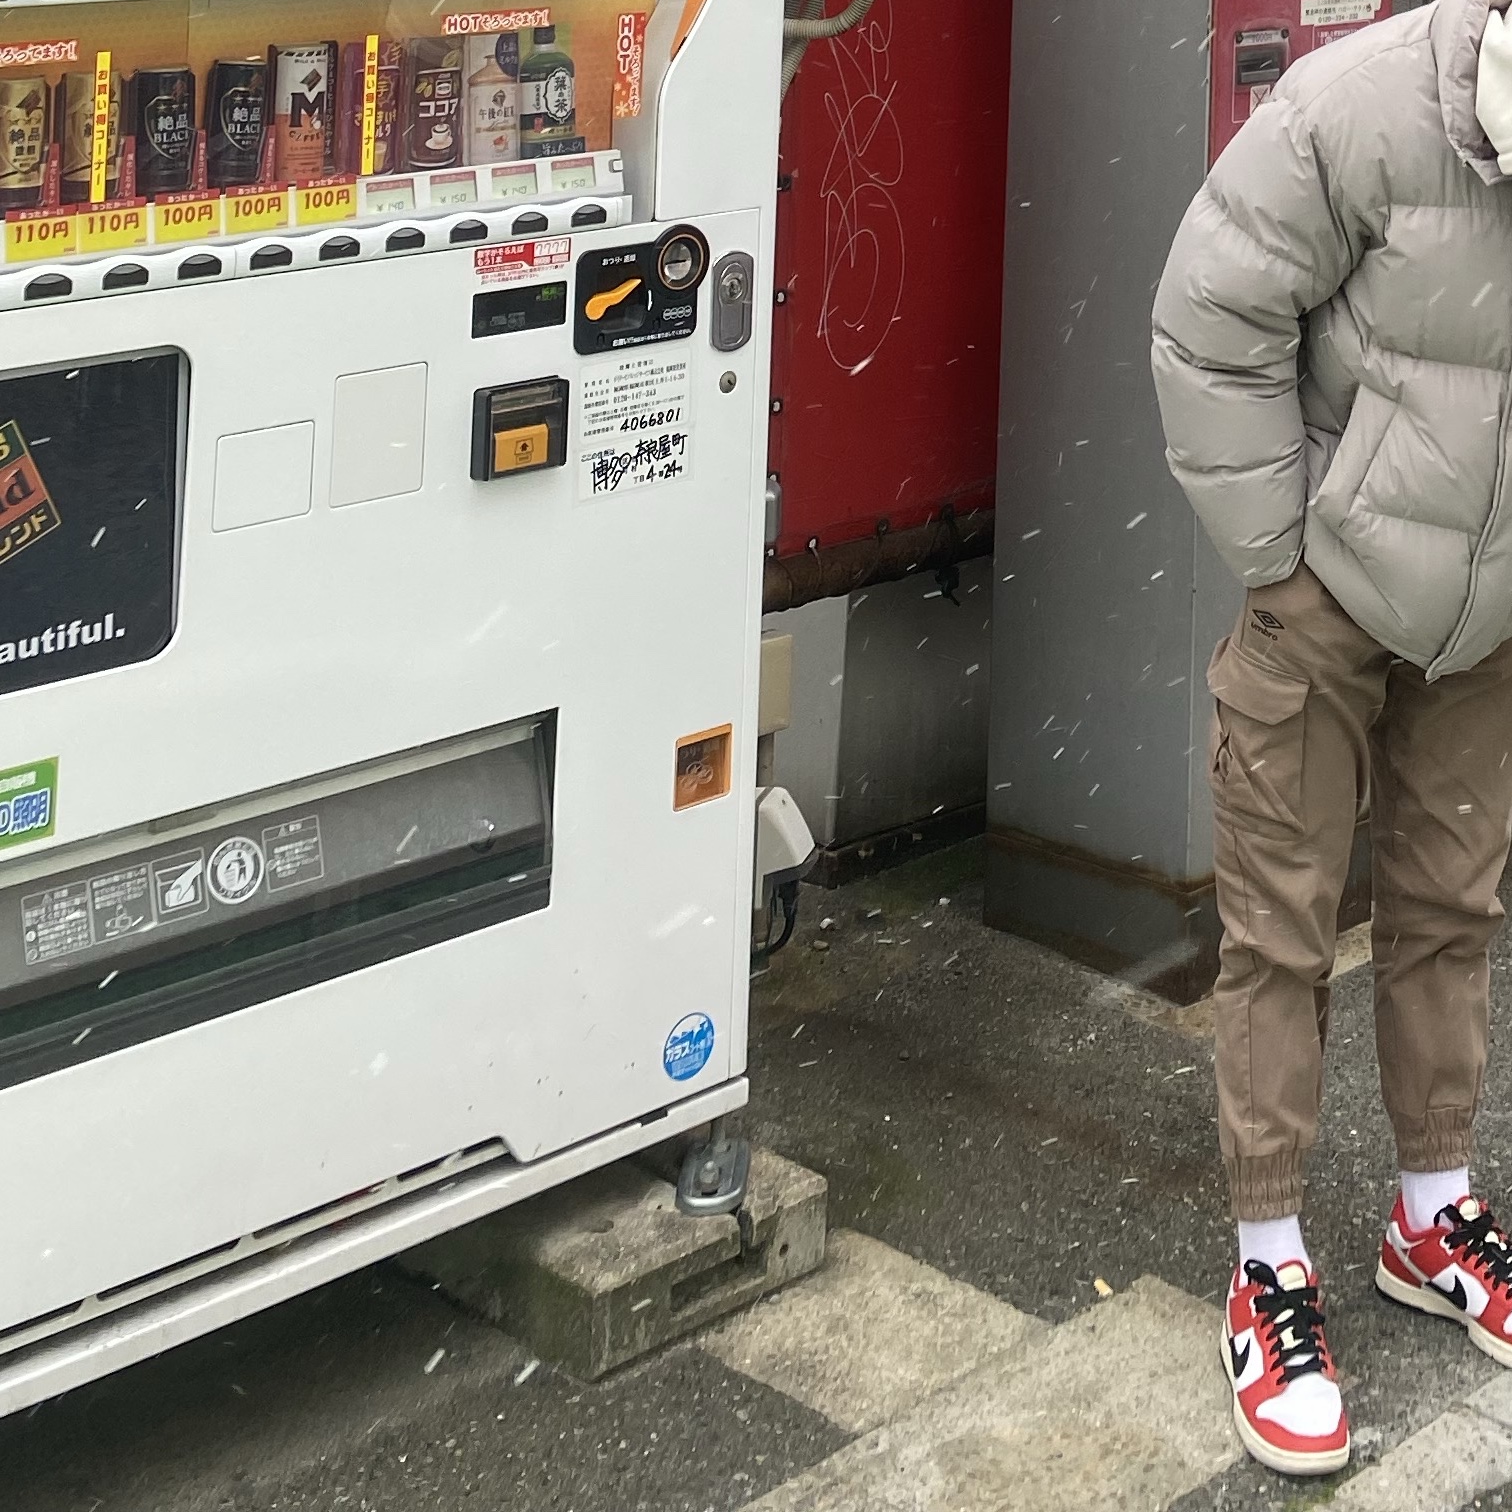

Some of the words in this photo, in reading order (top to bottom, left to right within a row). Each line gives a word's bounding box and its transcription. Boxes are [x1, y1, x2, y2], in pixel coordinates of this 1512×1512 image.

[0, 40, 78, 63] ろってます!
[618, 14, 635, 74] HOT
[157, 113, 188, 131] 絶品
[234, 196, 282, 218] 100円
[304, 188, 351, 210] 100円
[88, 212, 140, 235] 110円
[163, 204, 213, 227] 100円
[15, 220, 70, 244] 110円
[620, 407, 681, 432] 4066801
[0, 612, 126, 665] autiful.
